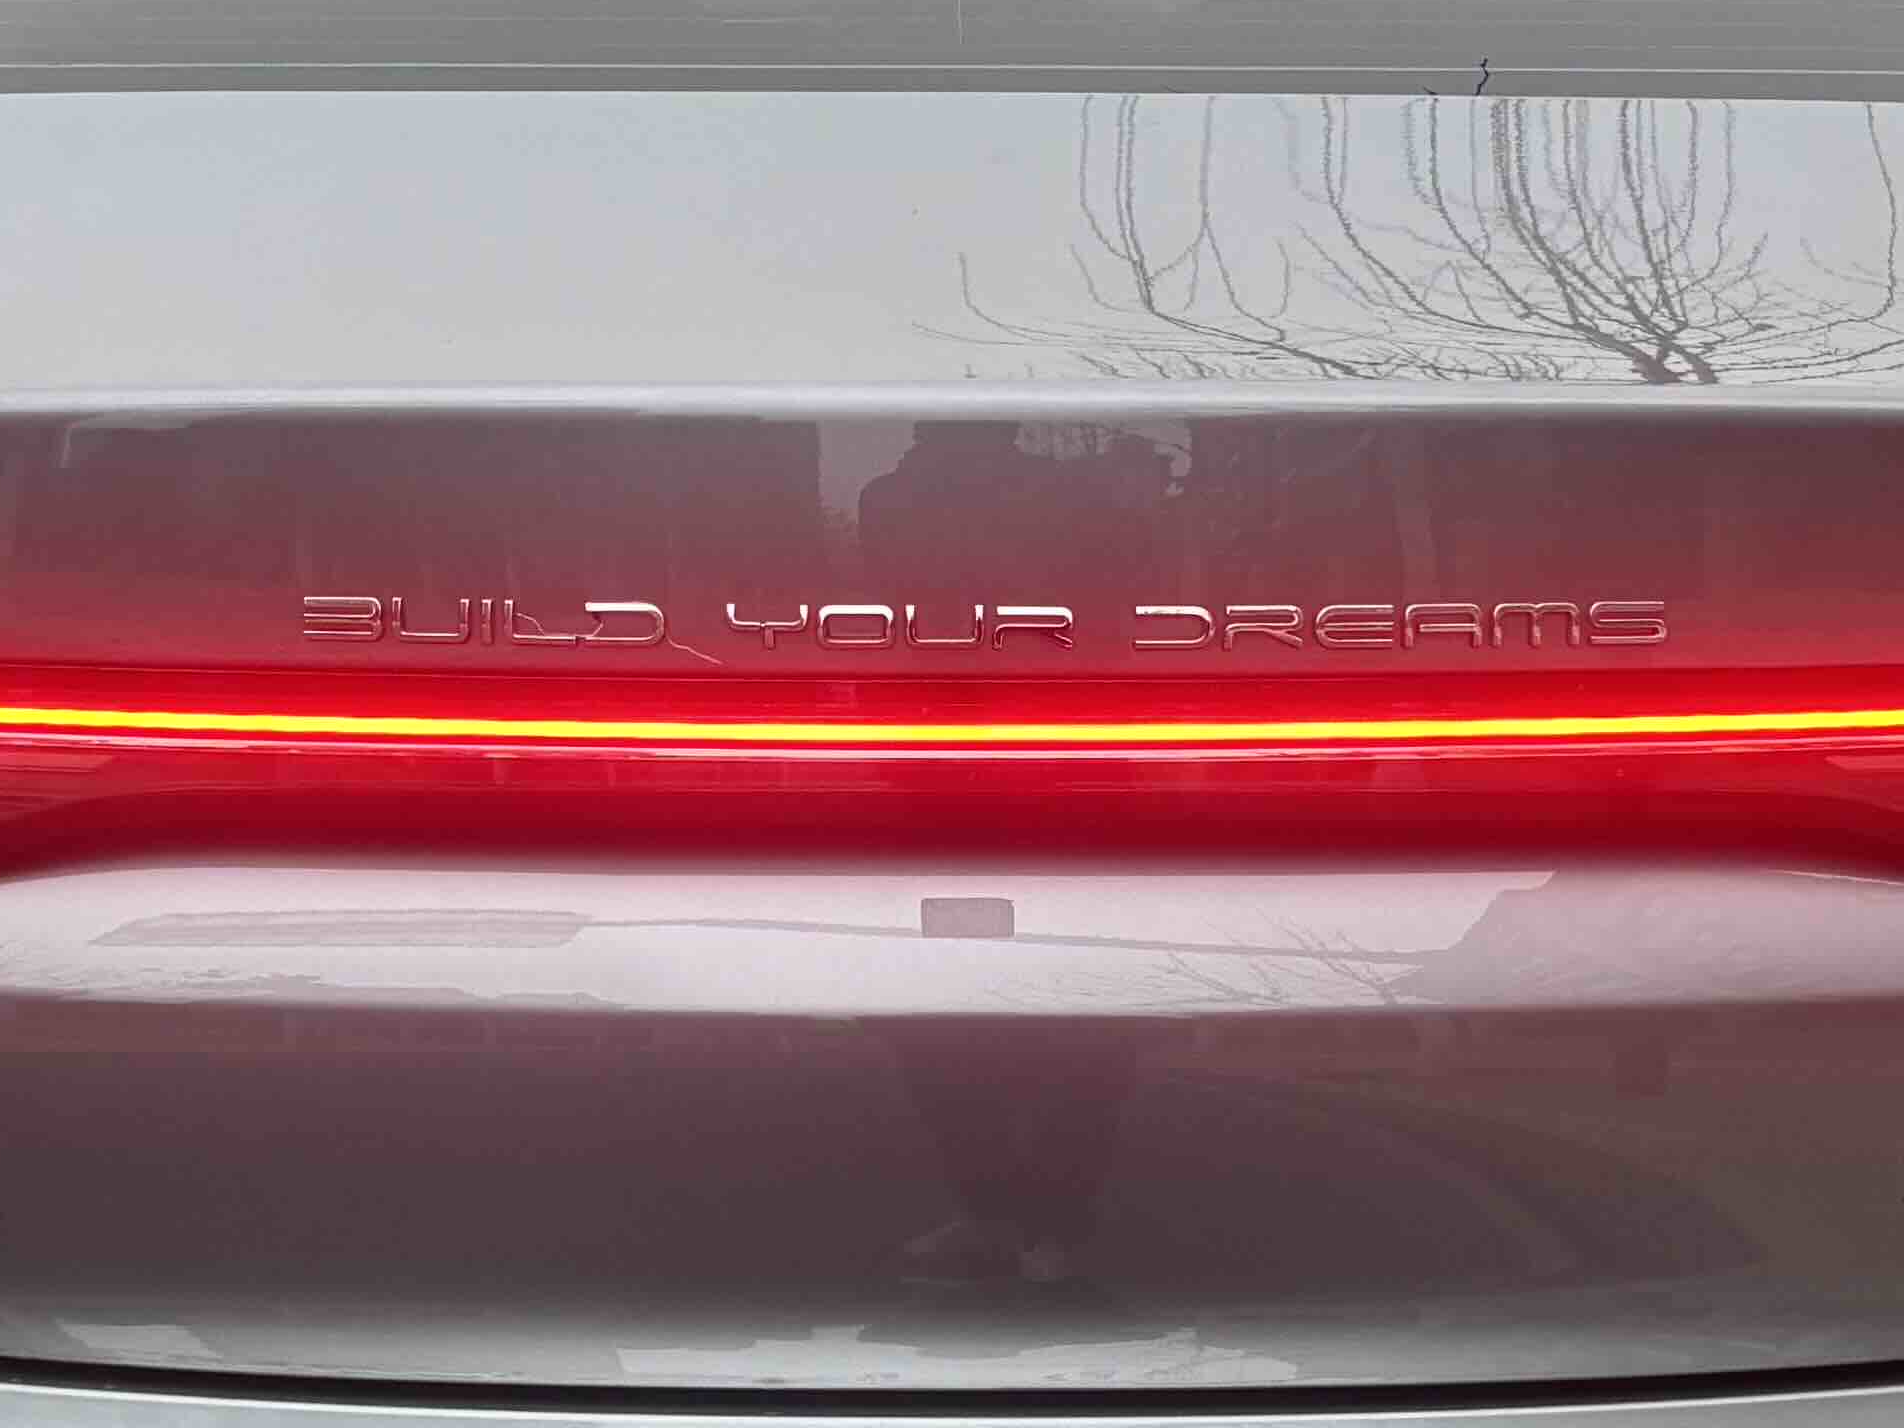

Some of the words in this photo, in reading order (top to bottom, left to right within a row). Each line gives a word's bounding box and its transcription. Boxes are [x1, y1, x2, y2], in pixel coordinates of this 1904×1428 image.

[301, 593, 666, 647] BUILD
[724, 601, 1077, 653] YOUR
[1132, 598, 1670, 654] DREAMS
